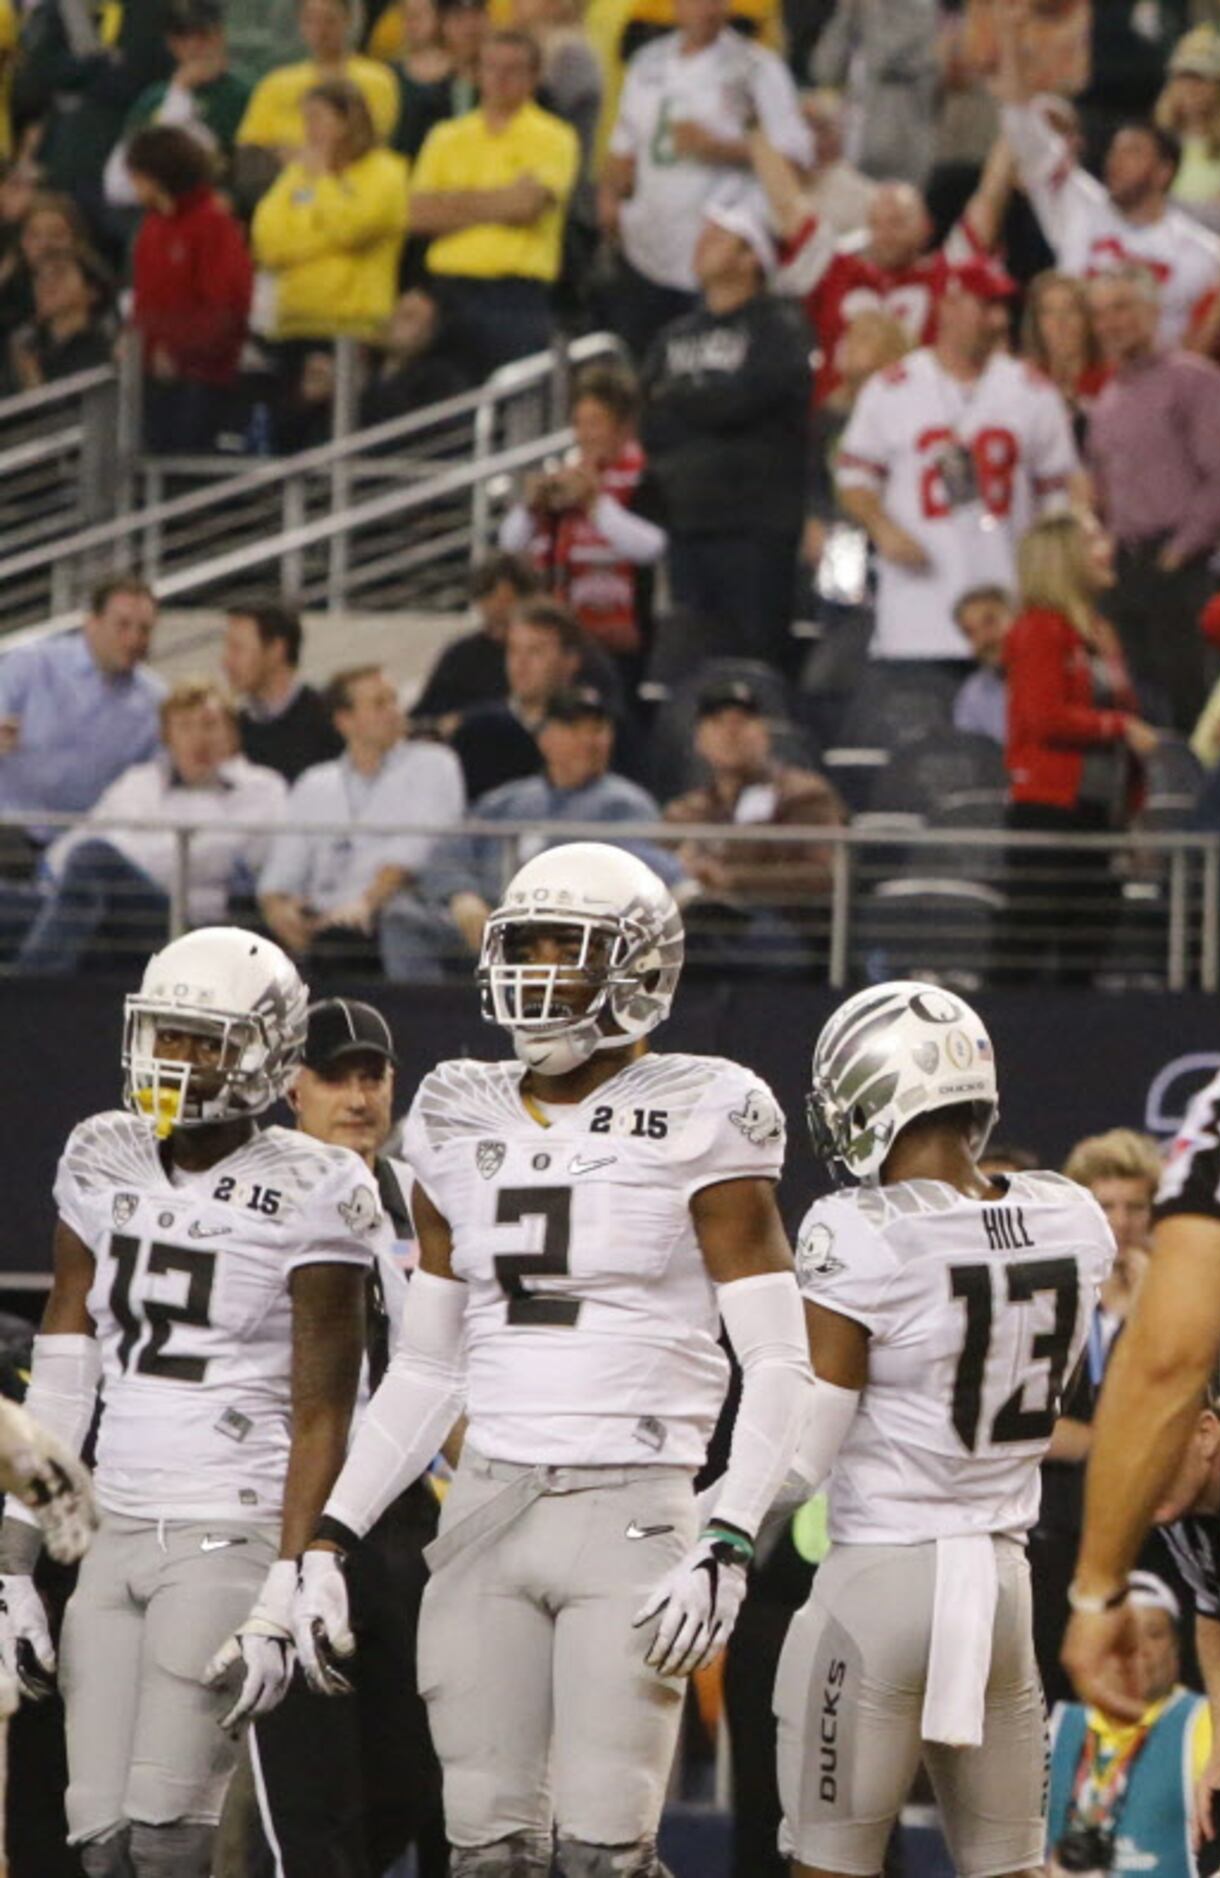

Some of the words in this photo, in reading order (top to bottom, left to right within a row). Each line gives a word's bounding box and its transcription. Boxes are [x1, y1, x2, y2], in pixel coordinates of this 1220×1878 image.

[494, 1186, 580, 1326] 2
[981, 1207, 1035, 1251] HILL
[109, 1233, 217, 1383] 12
[949, 1256, 1080, 1451] 13
[818, 1658, 847, 1804] DUCKS
